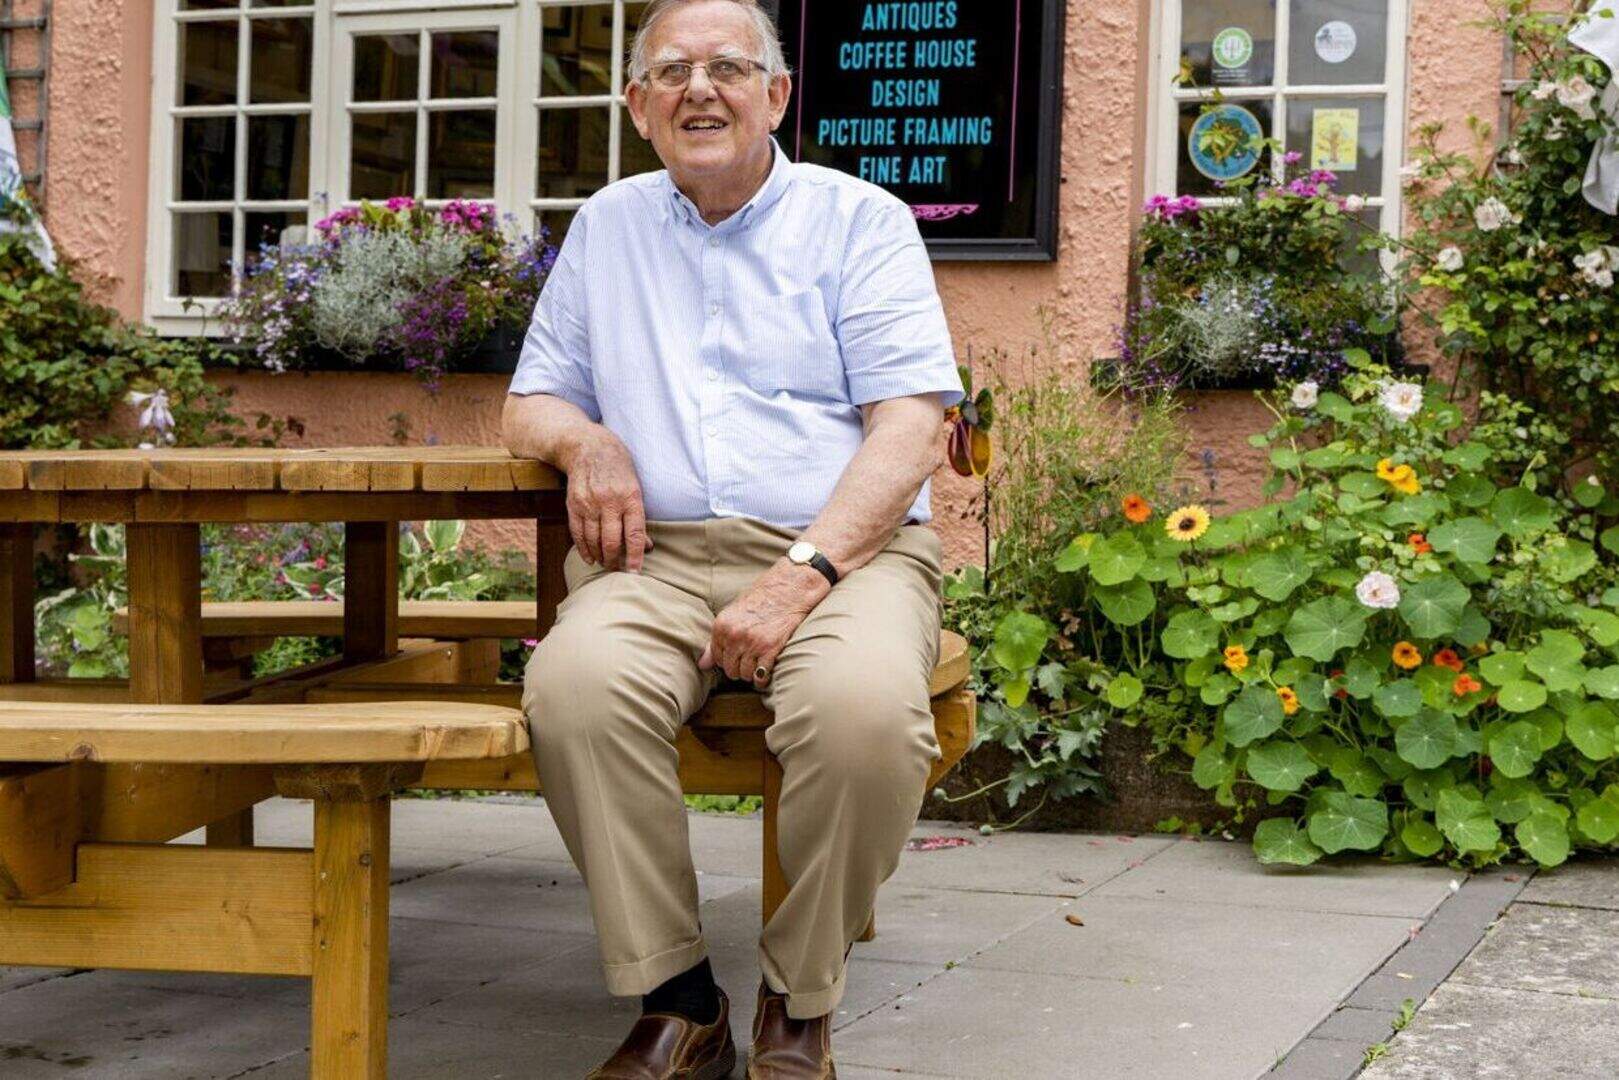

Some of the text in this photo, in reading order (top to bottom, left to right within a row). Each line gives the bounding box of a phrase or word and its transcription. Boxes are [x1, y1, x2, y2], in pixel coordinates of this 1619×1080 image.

[861, 1, 957, 32] ANTIQUES
[839, 39, 976, 70] COFFEE HOUSE
[871, 79, 940, 107] DESIGN
[818, 116, 992, 146] PICTURE FRAMING
[859, 156, 947, 184] FINE ART
